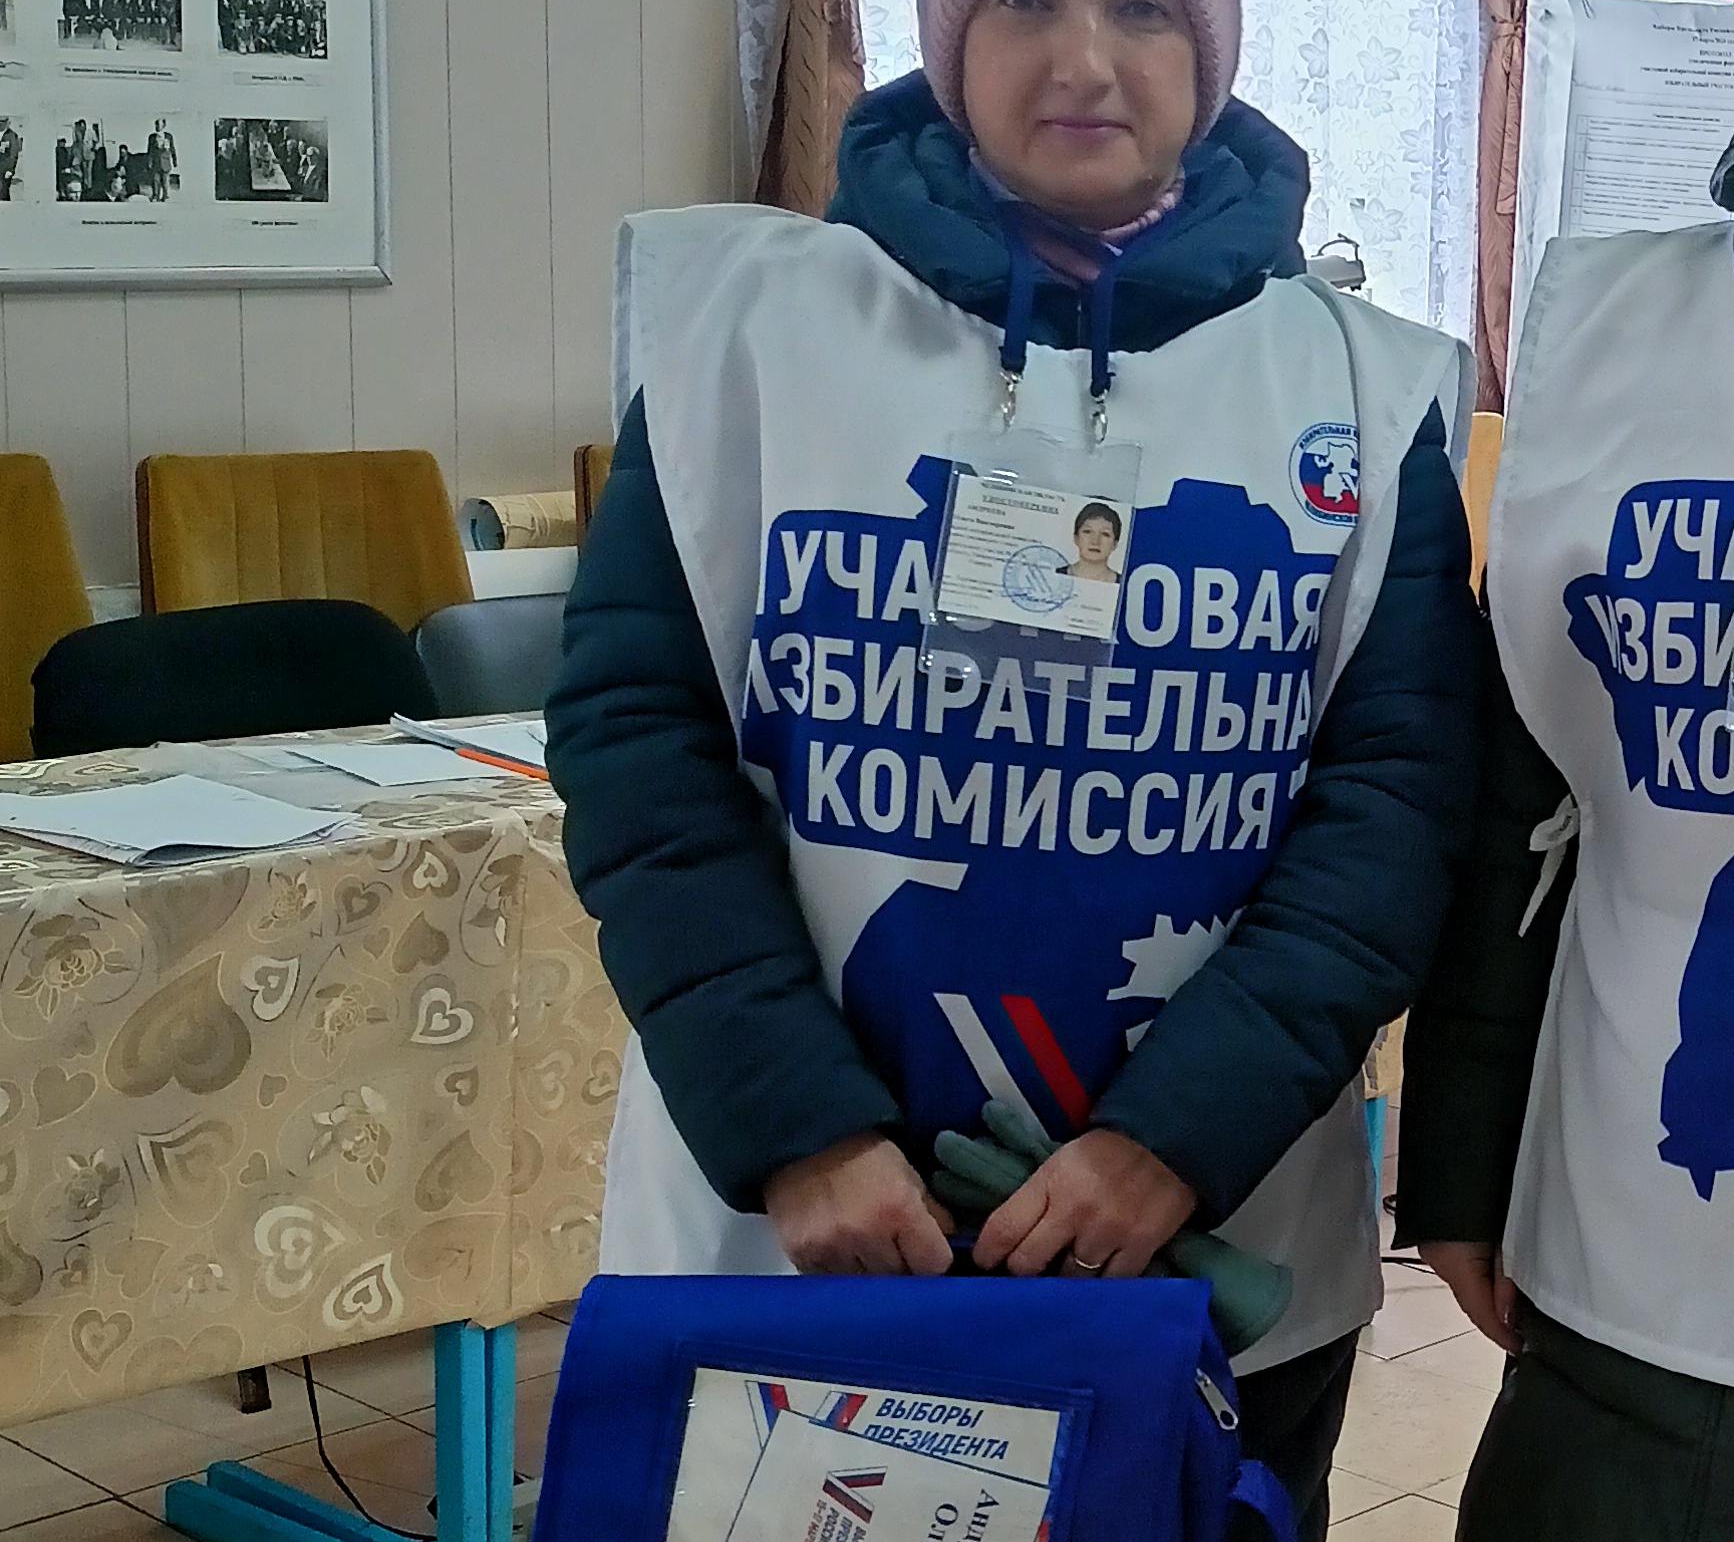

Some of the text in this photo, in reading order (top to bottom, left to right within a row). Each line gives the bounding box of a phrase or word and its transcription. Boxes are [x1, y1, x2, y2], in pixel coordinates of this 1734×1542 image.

[807, 740, 1278, 855] КОМИССИЯ
[875, 1397, 984, 1429] ВЫБОРЫ
[863, 1423, 1010, 1461] ПРЕЗИДЕНТА
